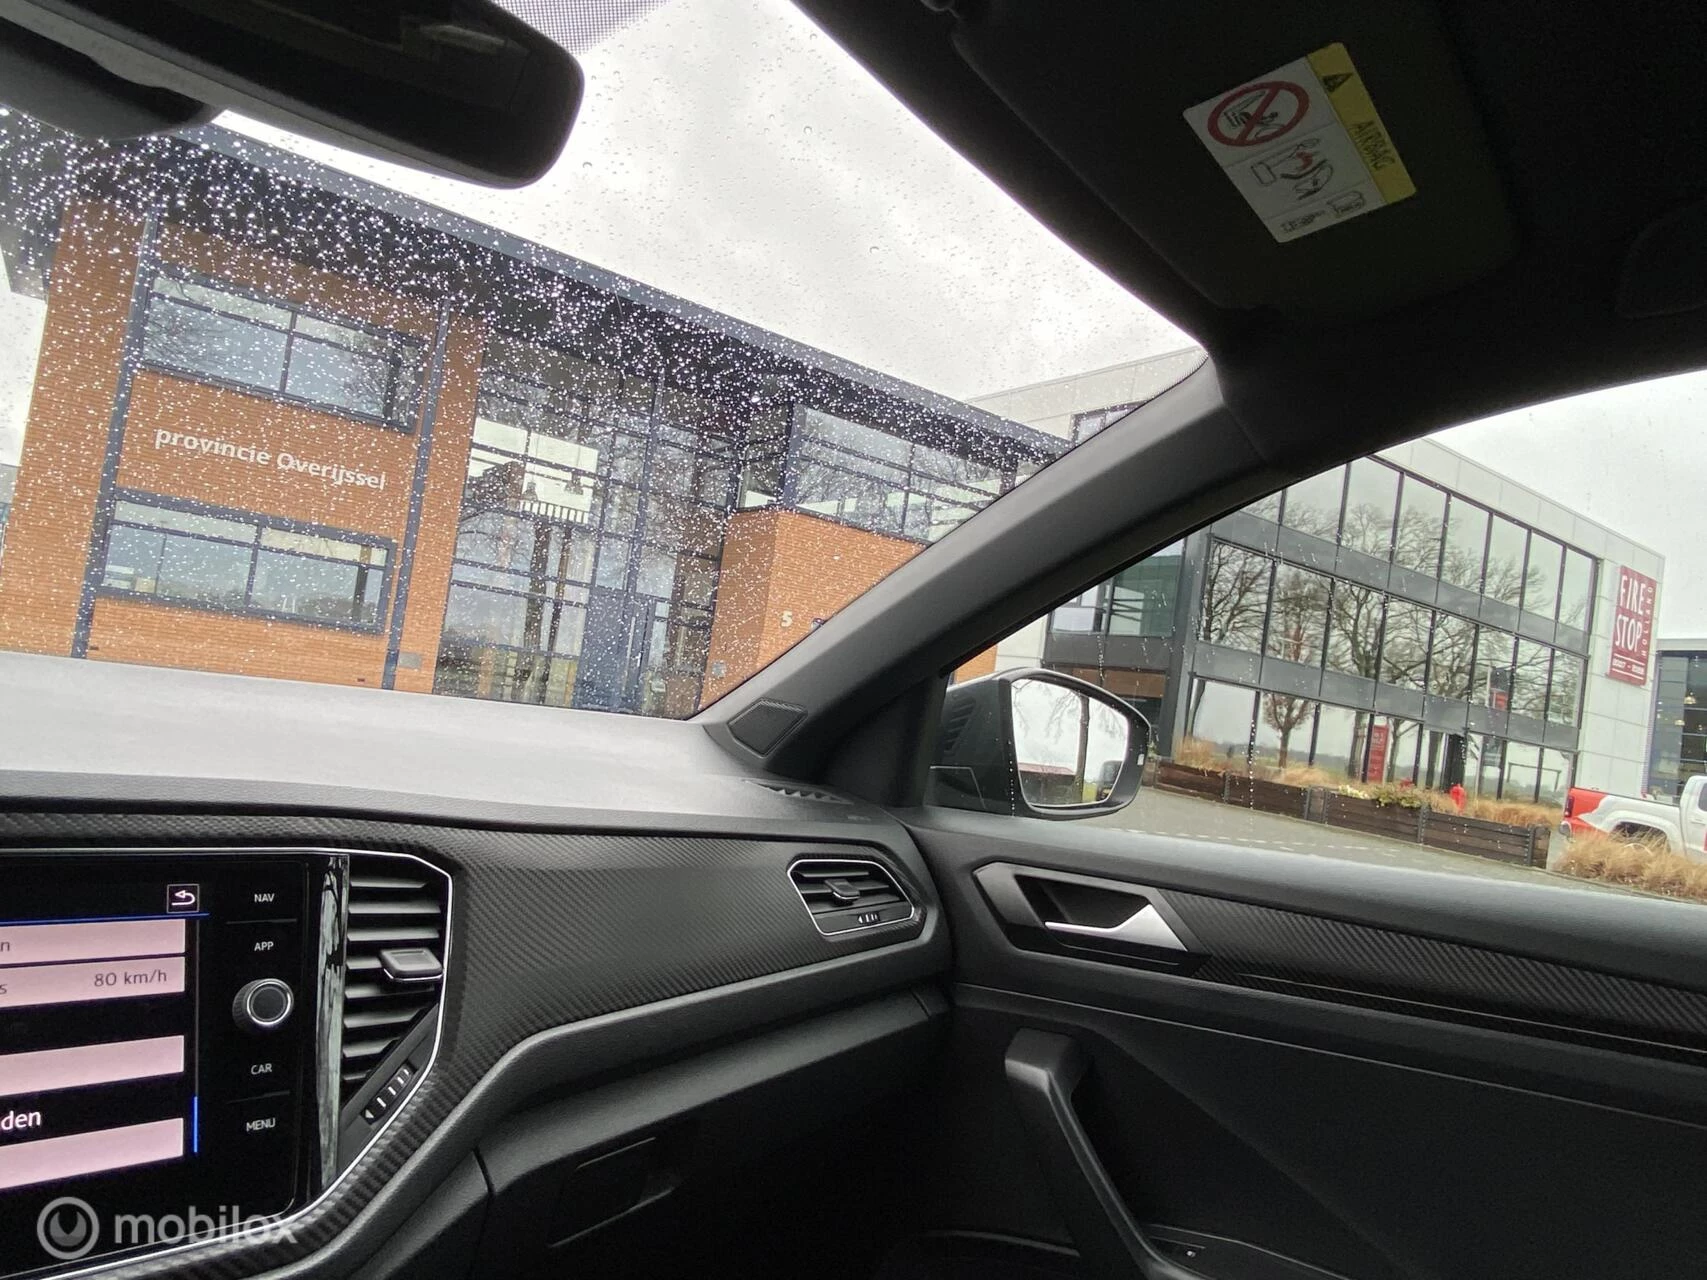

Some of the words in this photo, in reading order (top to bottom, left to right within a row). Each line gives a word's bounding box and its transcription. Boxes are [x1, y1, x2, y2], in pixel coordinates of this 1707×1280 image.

[1350, 120, 1396, 170] AIRBAG
[155, 428, 272, 466] provincie
[276, 452, 387, 490] Overijssel
[1620, 575, 1646, 615] FIRE
[1615, 614, 1643, 652] STOP
[254, 892, 275, 903] NAV
[254, 940, 274, 952] APP
[94, 972, 117, 987] 80
[123, 969, 167, 986] km/h
[250, 1062, 273, 1075] CAR
[246, 1117, 276, 1132] MENU
